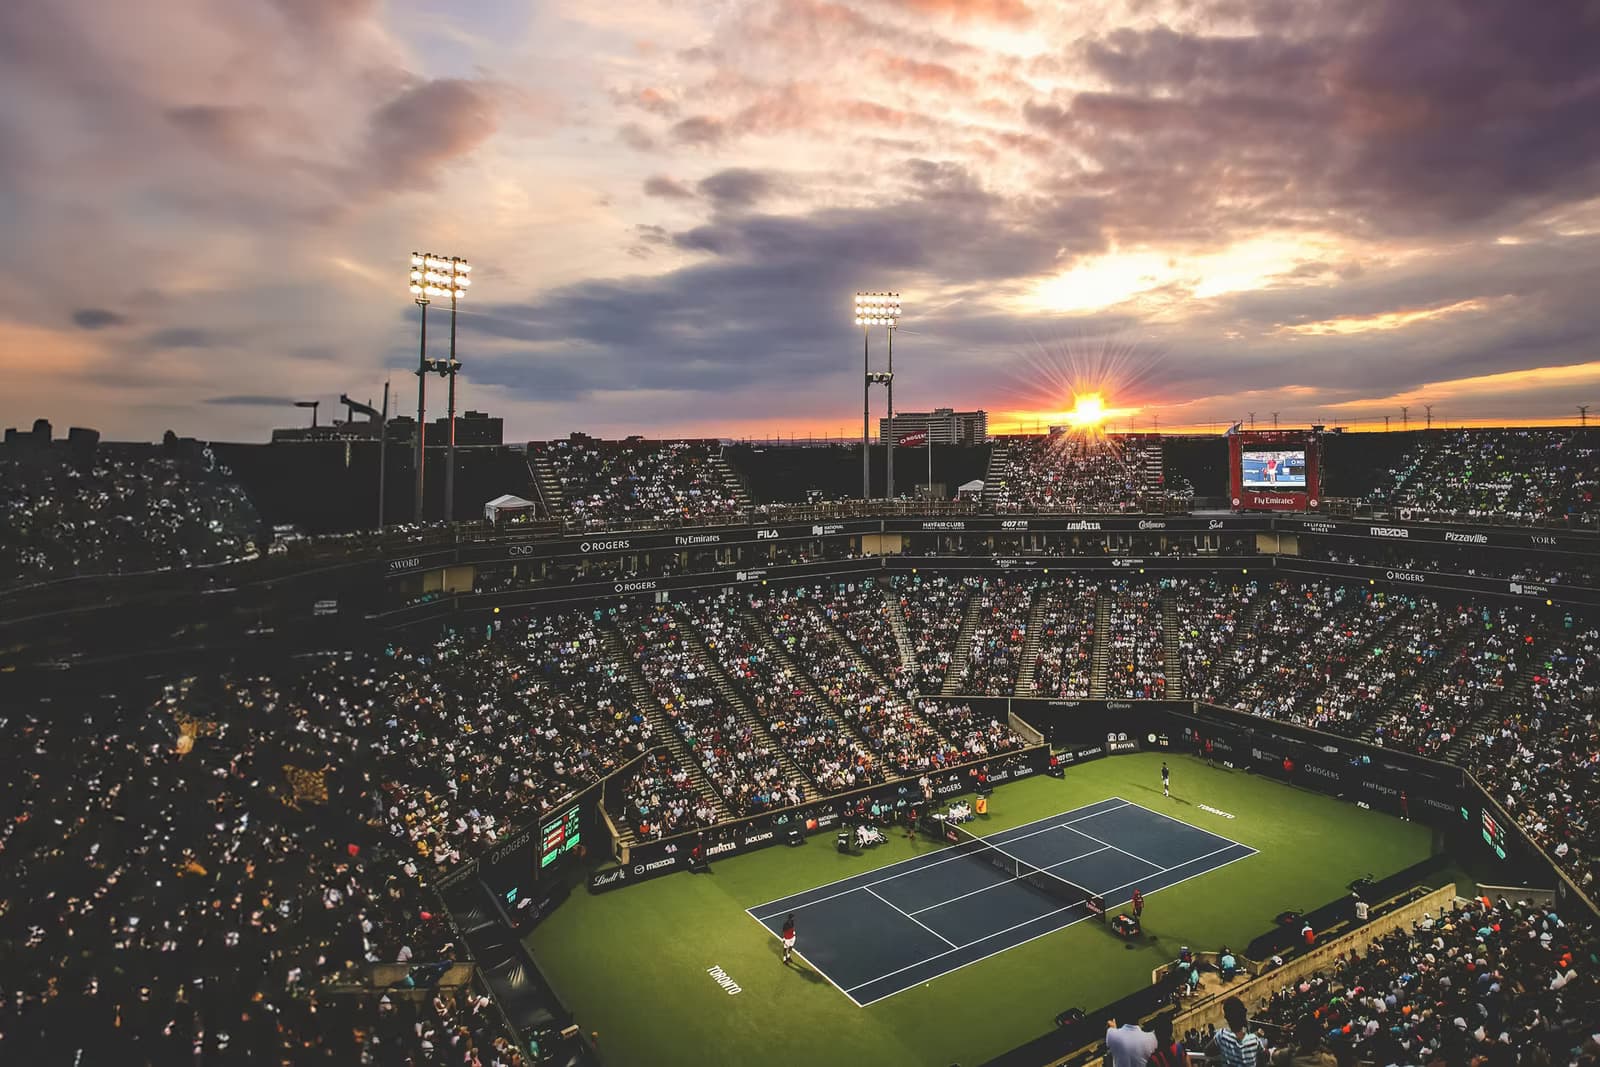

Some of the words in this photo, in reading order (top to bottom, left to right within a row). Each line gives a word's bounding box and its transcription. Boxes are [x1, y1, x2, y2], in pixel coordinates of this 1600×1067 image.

[1254, 497, 1265, 505] Fly
[1265, 497, 1294, 505] Emirates
[1001, 520, 1017, 528] 407
[757, 529, 779, 540] FILA
[1370, 526, 1409, 538] mazda
[1444, 531, 1488, 544] Pizzaville
[592, 540, 631, 551] ROGERS
[675, 536, 687, 546] Fly
[688, 534, 720, 545] Emirates
[1530, 535, 1558, 545] YORK
[390, 558, 420, 571] SWORD
[1394, 571, 1425, 583] ROGERS
[624, 581, 657, 592] ROGERS
[1117, 743, 1135, 751] AVIVA
[1312, 766, 1340, 781] ROGERS
[938, 782, 962, 794] ROGERS
[646, 857, 676, 871] mazda
[593, 871, 619, 887] Lindt
[706, 964, 743, 996] TORONTO
